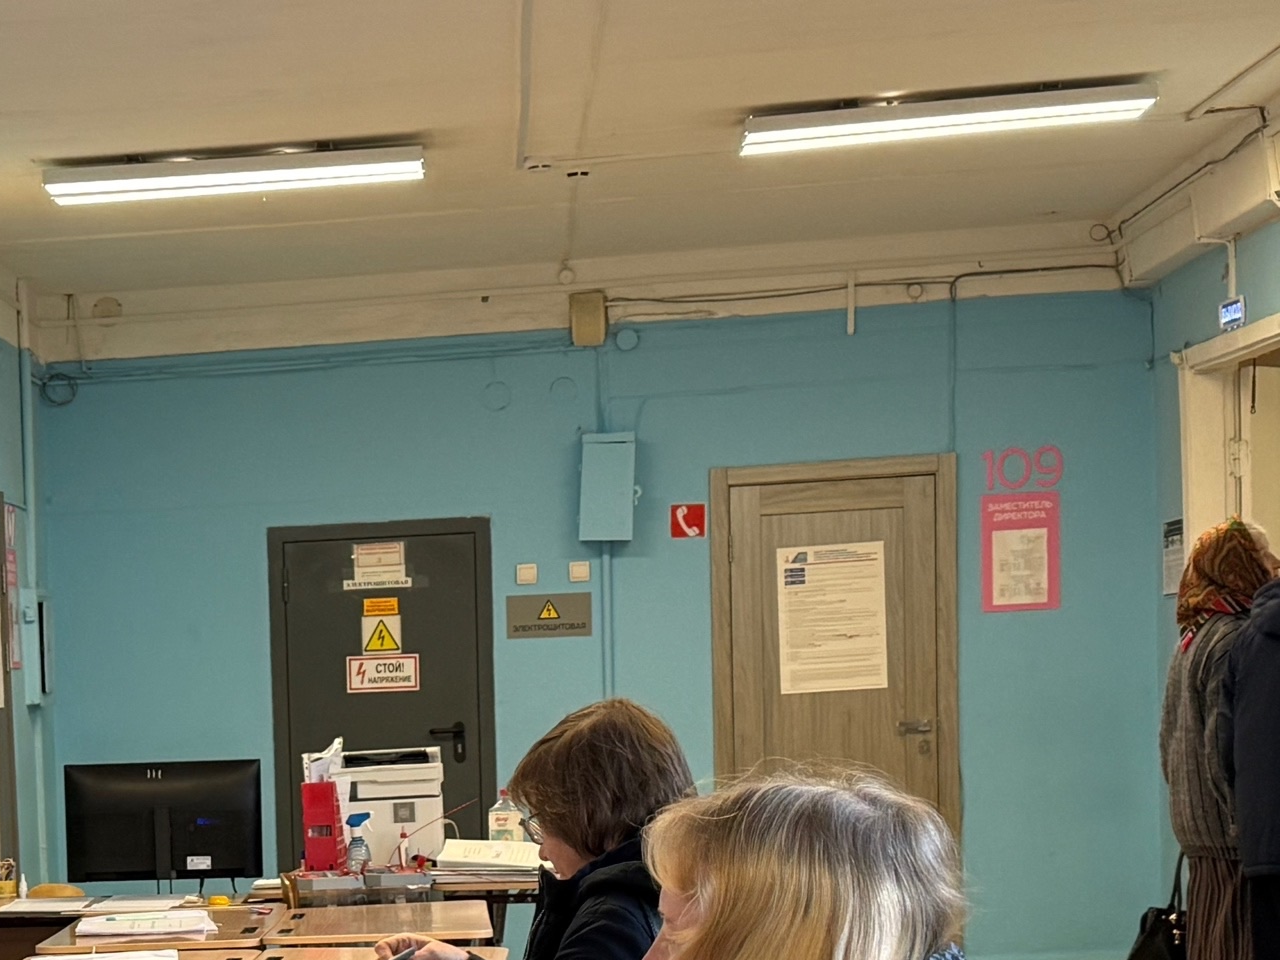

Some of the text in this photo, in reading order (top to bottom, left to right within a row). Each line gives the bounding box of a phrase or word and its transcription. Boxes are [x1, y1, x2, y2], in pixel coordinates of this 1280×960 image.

[980, 444, 1064, 490] 109
[987, 500, 1054, 512] ЗАМЕСТИТЕЛЬ
[992, 510, 1047, 522] ДИРЕКТОРА
[512, 622, 587, 633] ЭЛЕКТРОЩИТОВАЯ
[375, 660, 405, 674] СТОЙ!
[368, 674, 412, 685] НАПРЯЖЕНИЕ
